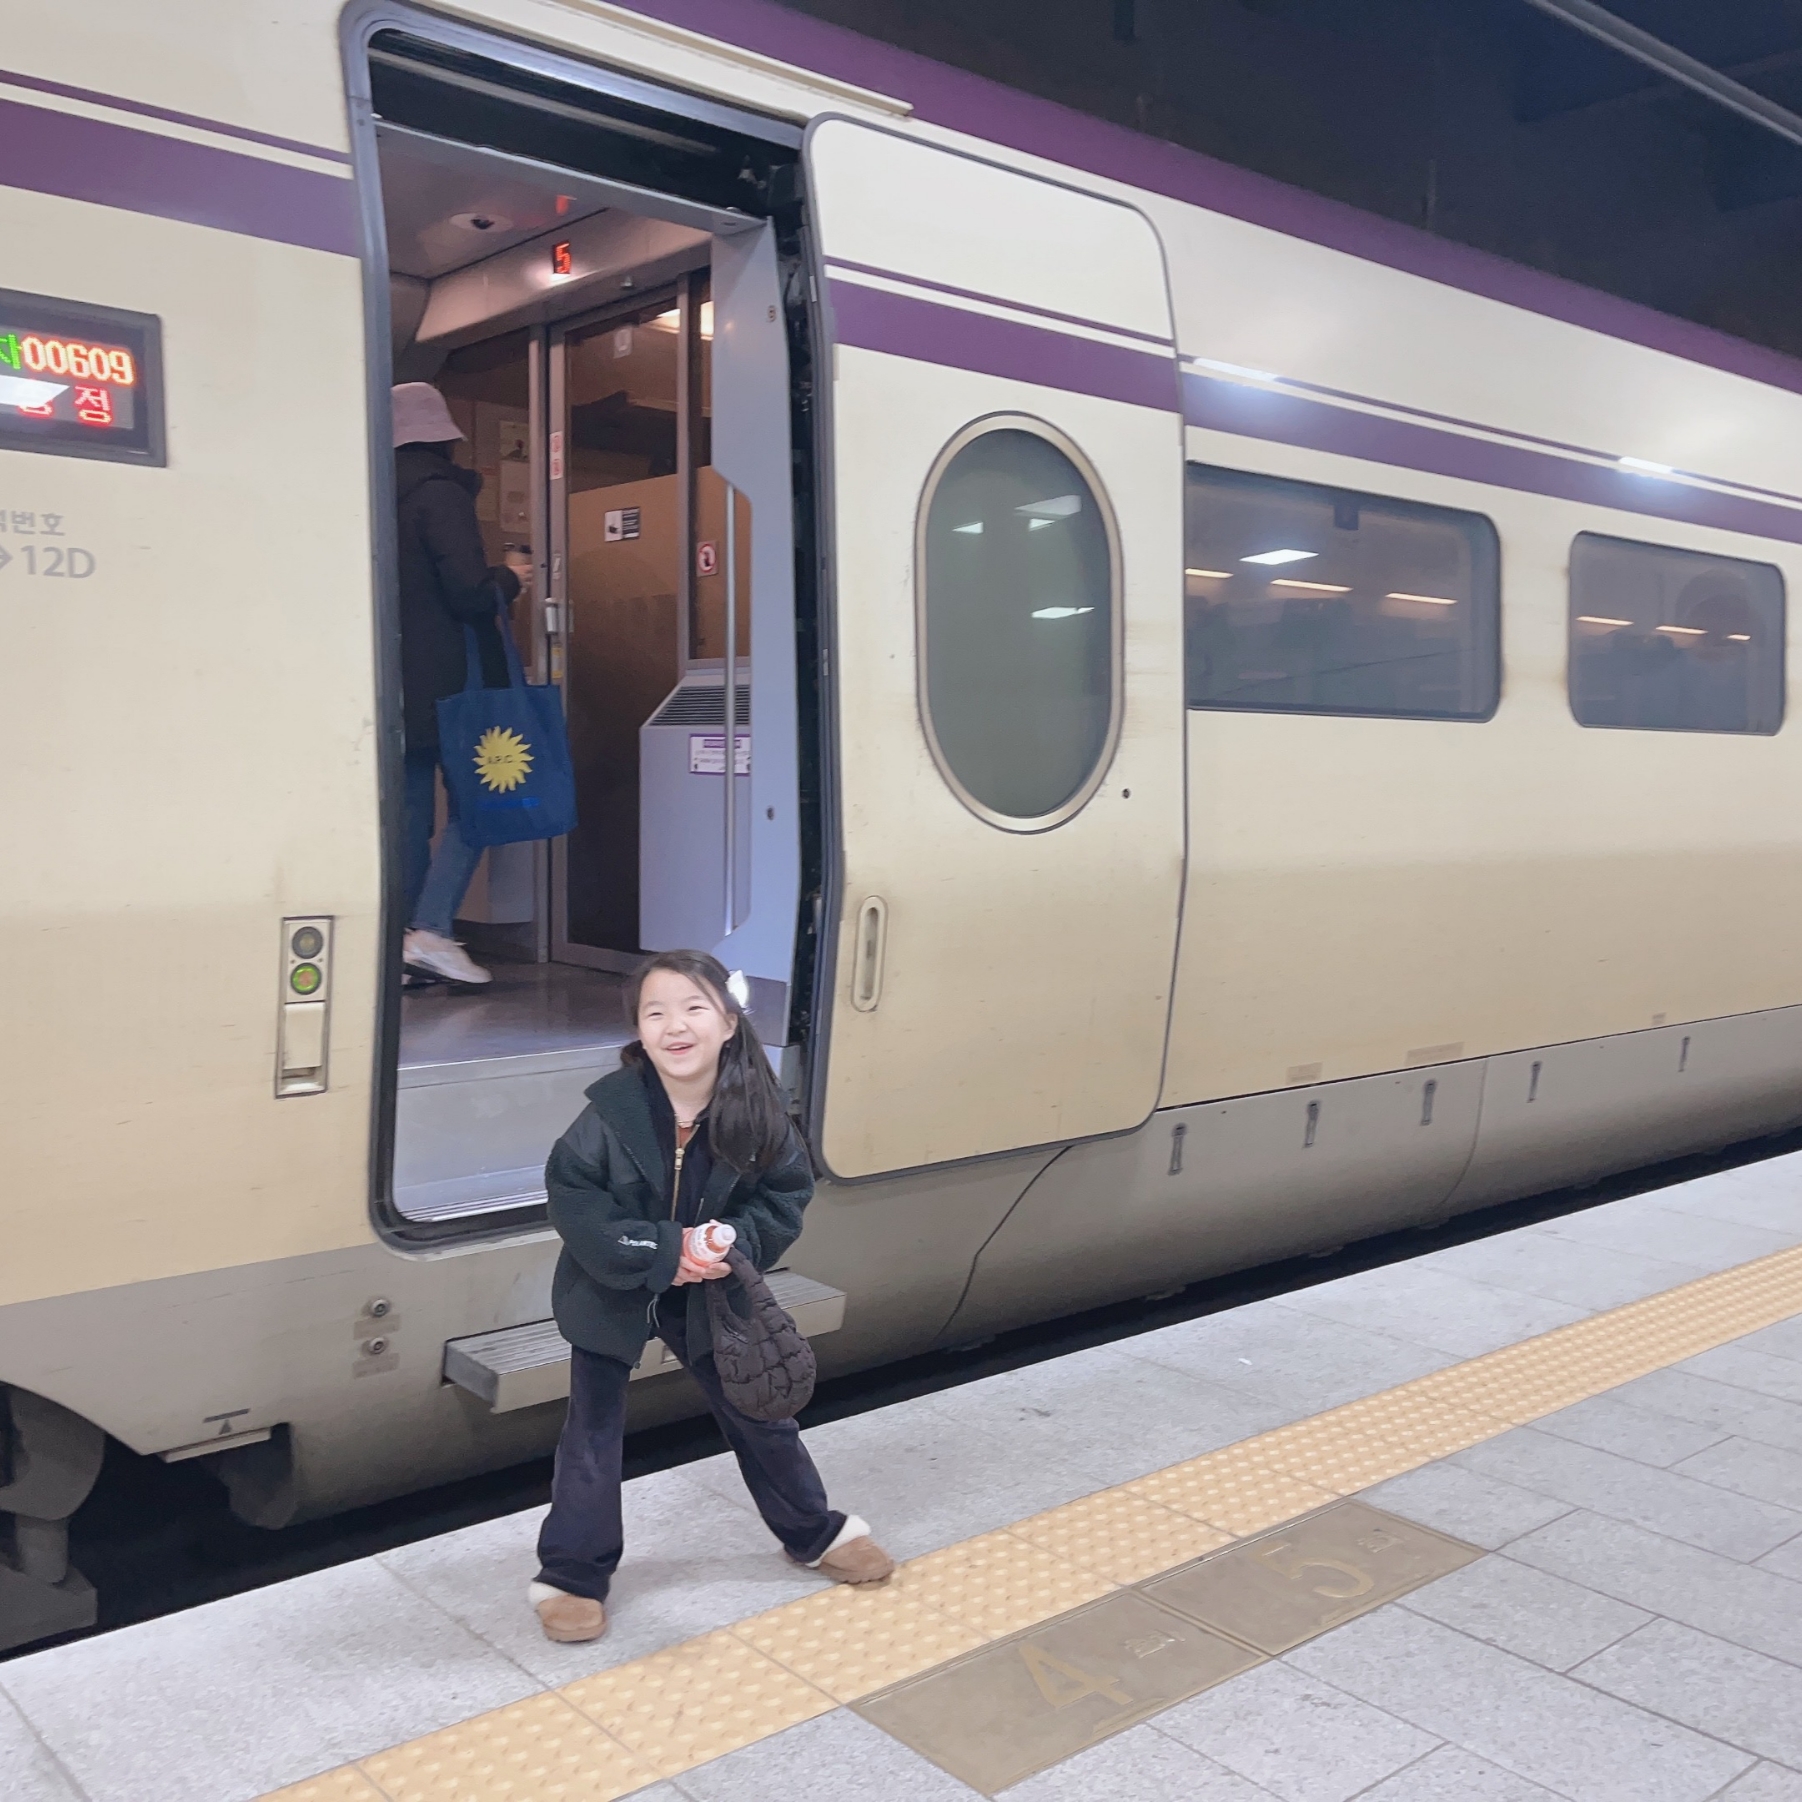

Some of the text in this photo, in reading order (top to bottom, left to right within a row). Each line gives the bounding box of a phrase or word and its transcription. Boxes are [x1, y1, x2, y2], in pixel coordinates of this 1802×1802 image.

[555, 242, 571, 273] 5
[20, 544, 97, 579] 12D
[1250, 1539, 1374, 1599] 5
[1018, 1640, 1133, 1709] 4
